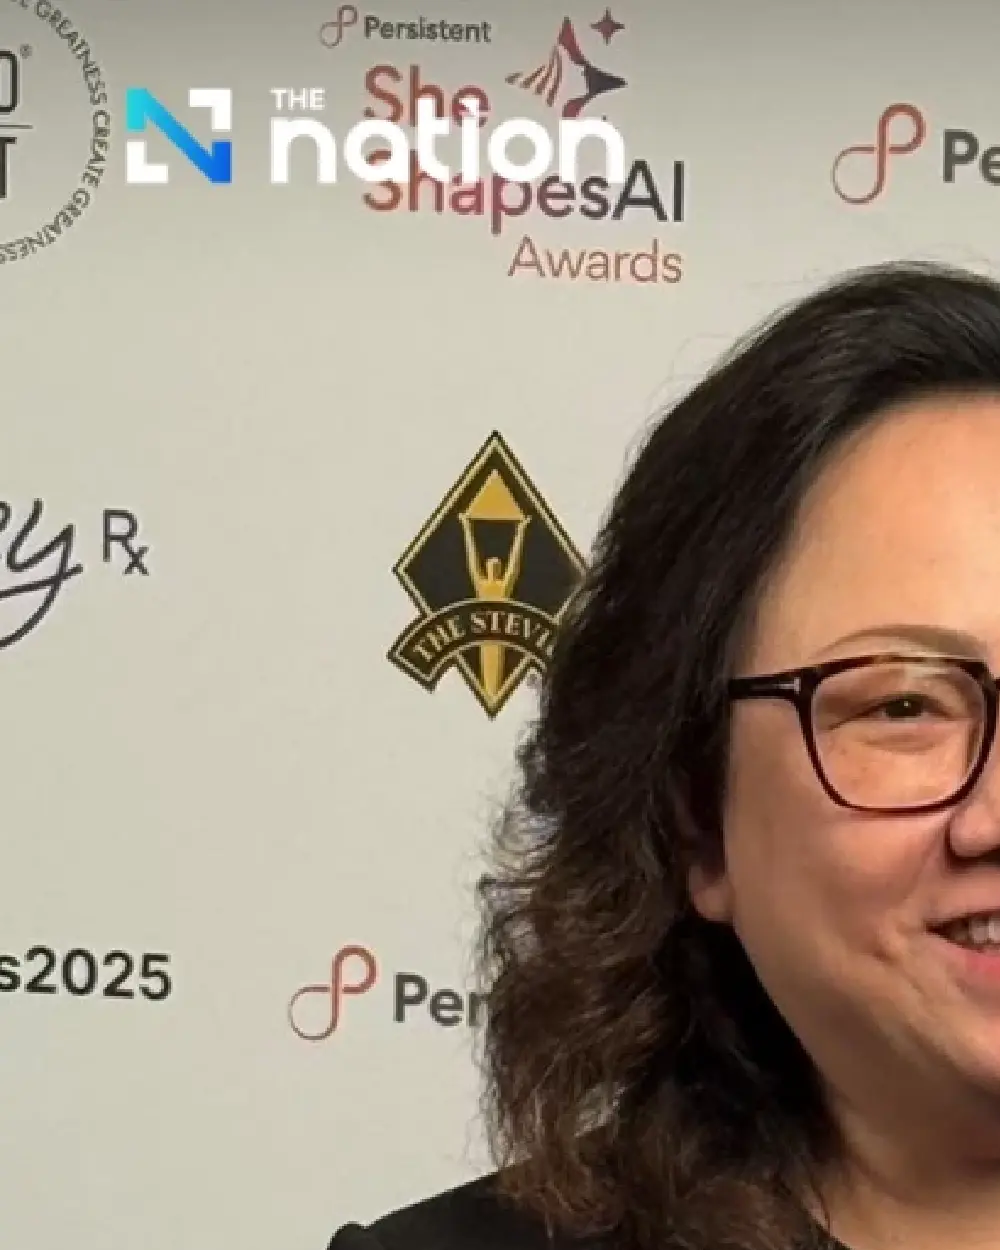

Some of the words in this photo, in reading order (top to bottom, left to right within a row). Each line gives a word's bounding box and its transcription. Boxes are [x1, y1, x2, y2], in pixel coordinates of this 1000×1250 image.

[363, 15, 492, 43] Persistent
[363, 64, 491, 128] She
[507, 234, 683, 285] Awards
[413, 614, 467, 662] THE
[0, 945, 172, 1001] s2025
